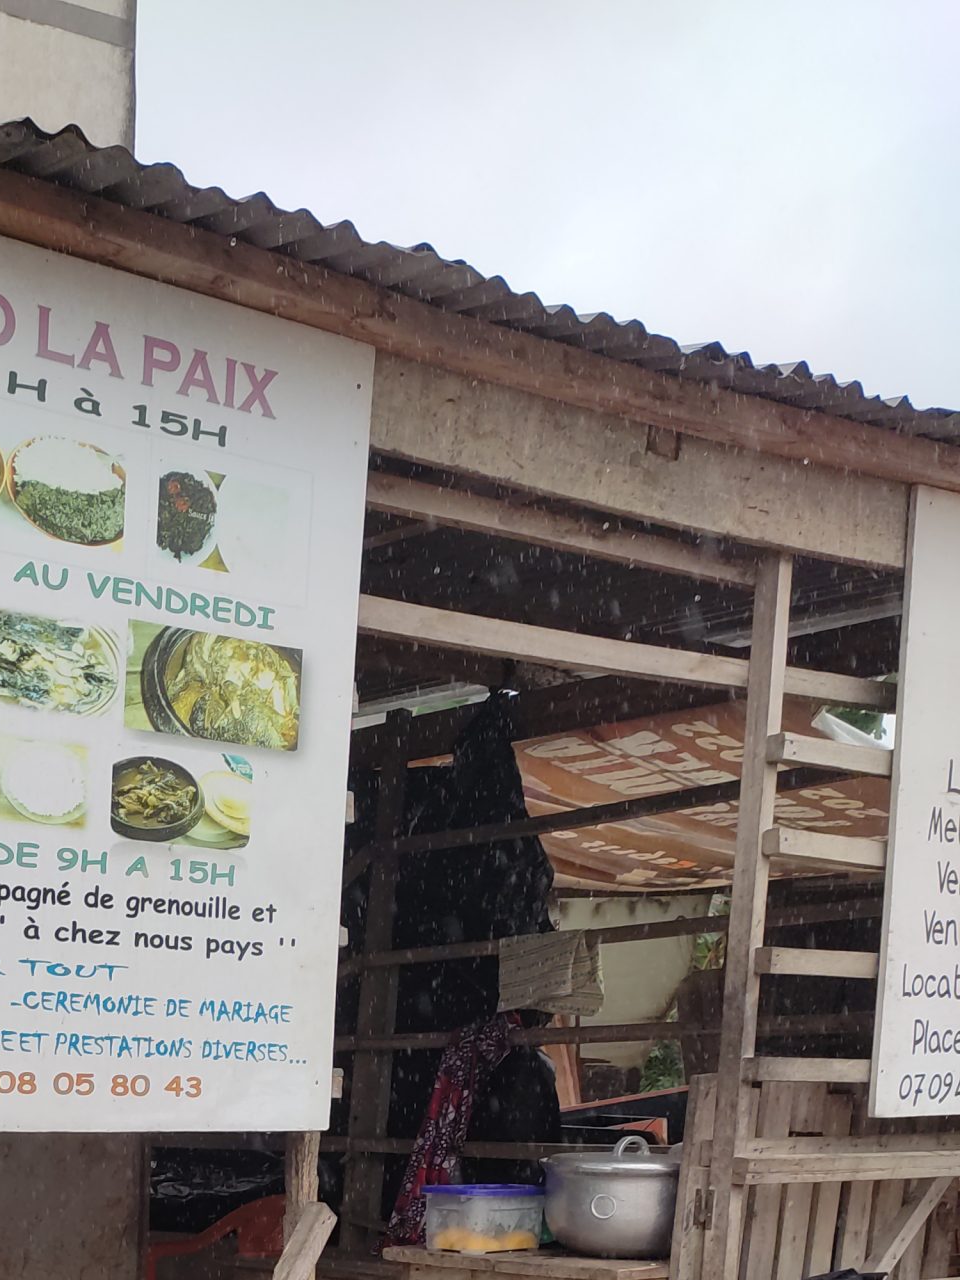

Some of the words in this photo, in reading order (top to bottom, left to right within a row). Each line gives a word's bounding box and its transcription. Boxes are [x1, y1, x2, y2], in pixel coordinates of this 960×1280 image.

[35, 304, 125, 379] LA
[141, 334, 279, 420] PAIX
[73, 387, 102, 417] à
[131, 404, 228, 447] 15H
[13, 561, 69, 590] AU
[87, 572, 275, 630] VENDREDI
[927, 806, 960, 843] Me
[56, 847, 107, 874] 9H
[125, 855, 149, 879] A
[170, 858, 236, 887] 15H
[83, 885, 114, 909] de
[126, 895, 241, 920] grenouille
[251, 903, 277, 924] et
[23, 916, 41, 941] à
[54, 921, 121, 946] chez
[134, 930, 193, 952] nous
[206, 936, 264, 962] pays
[18, 958, 129, 981] TOUT
[165, 998, 192, 1018] DE
[198, 999, 294, 1024] MARIAGE
[54, 1032, 192, 1059] PRESTATIONS
[52, 1072, 95, 1096] 05
[110, 1074, 151, 1097] 80
[164, 1075, 203, 1099] 43
